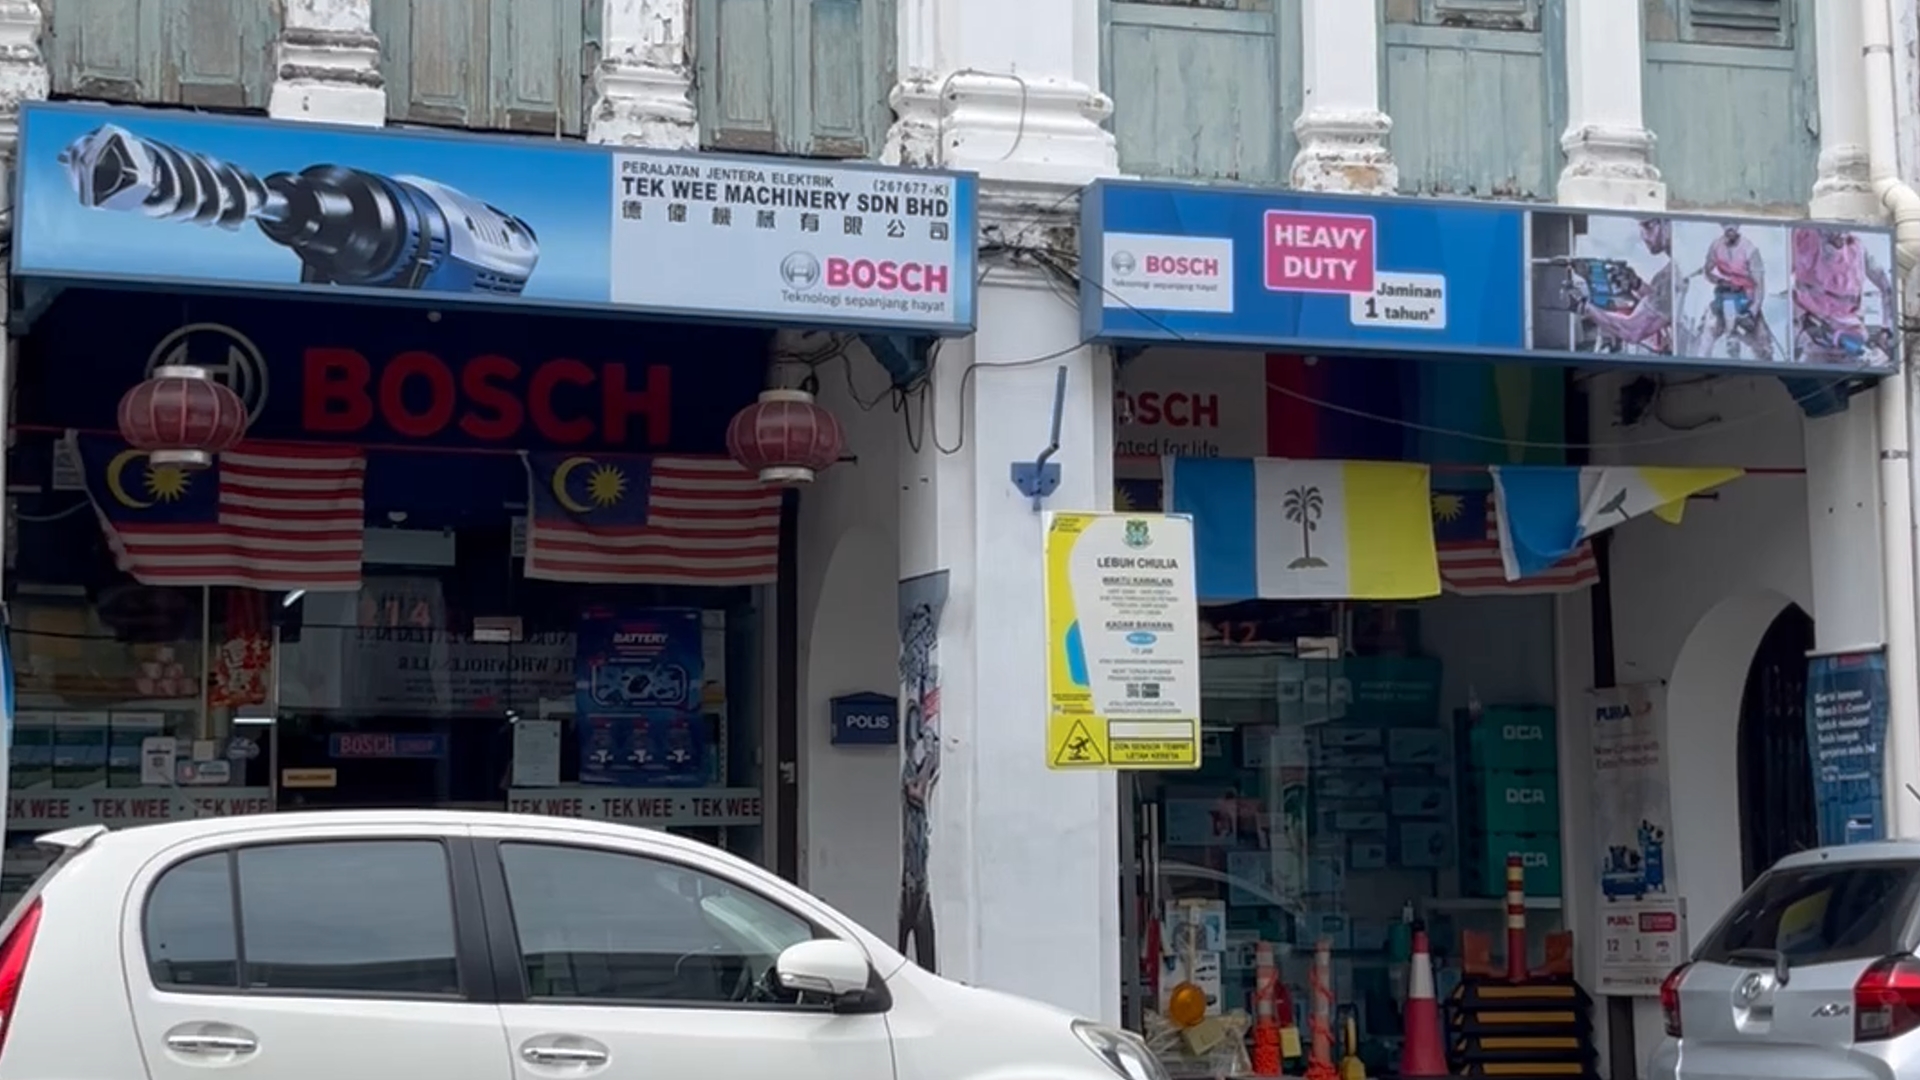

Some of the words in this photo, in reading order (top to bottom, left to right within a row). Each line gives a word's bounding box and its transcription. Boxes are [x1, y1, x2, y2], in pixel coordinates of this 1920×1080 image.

[622, 160, 699, 179] PERALATAN
[706, 167, 765, 184] JENTERA
[772, 172, 834, 188] ELEKTRIK
[622, 177, 665, 197] TEK
[673, 182, 718, 201] WEE
[725, 185, 850, 210] MACHINERY
[857, 194, 898, 214] SDN
[906, 198, 948, 218] BHD
[873, 178, 949, 197] (267677-K)
[1274, 223, 1368, 251] HEAVY
[826, 258, 947, 293] BOSCH
[1146, 255, 1218, 276] BOSCH
[1283, 255, 1358, 281] DUTY
[1377, 282, 1442, 299] Jaminan
[782, 289, 841, 307] Teknologi
[844, 295, 908, 312] sepanjang
[911, 298, 945, 313] hayat
[1364, 297, 1379, 319] 1
[301, 347, 674, 446] BOSCH
[1163, 438, 1188, 457] for
[1193, 439, 1219, 458] life
[1097, 557, 1135, 569] LEBUH
[1137, 558, 1179, 569] CHULIA
[612, 632, 669, 645] BATTERY
[845, 714, 890, 730] POLIS
[340, 736, 396, 754] BOSCH
[1505, 788, 1546, 805] DCA
[31, 798, 70, 818] WEE
[93, 798, 131, 818] TEK
[134, 799, 170, 818] WEE
[547, 798, 583, 817] WEE
[602, 798, 634, 817] TEK
[637, 799, 673, 818] WEE
[692, 798, 722, 817] TEK
[726, 798, 762, 817] WEE
[1607, 939, 1620, 951] 12
[1635, 939, 1641, 951] 1
